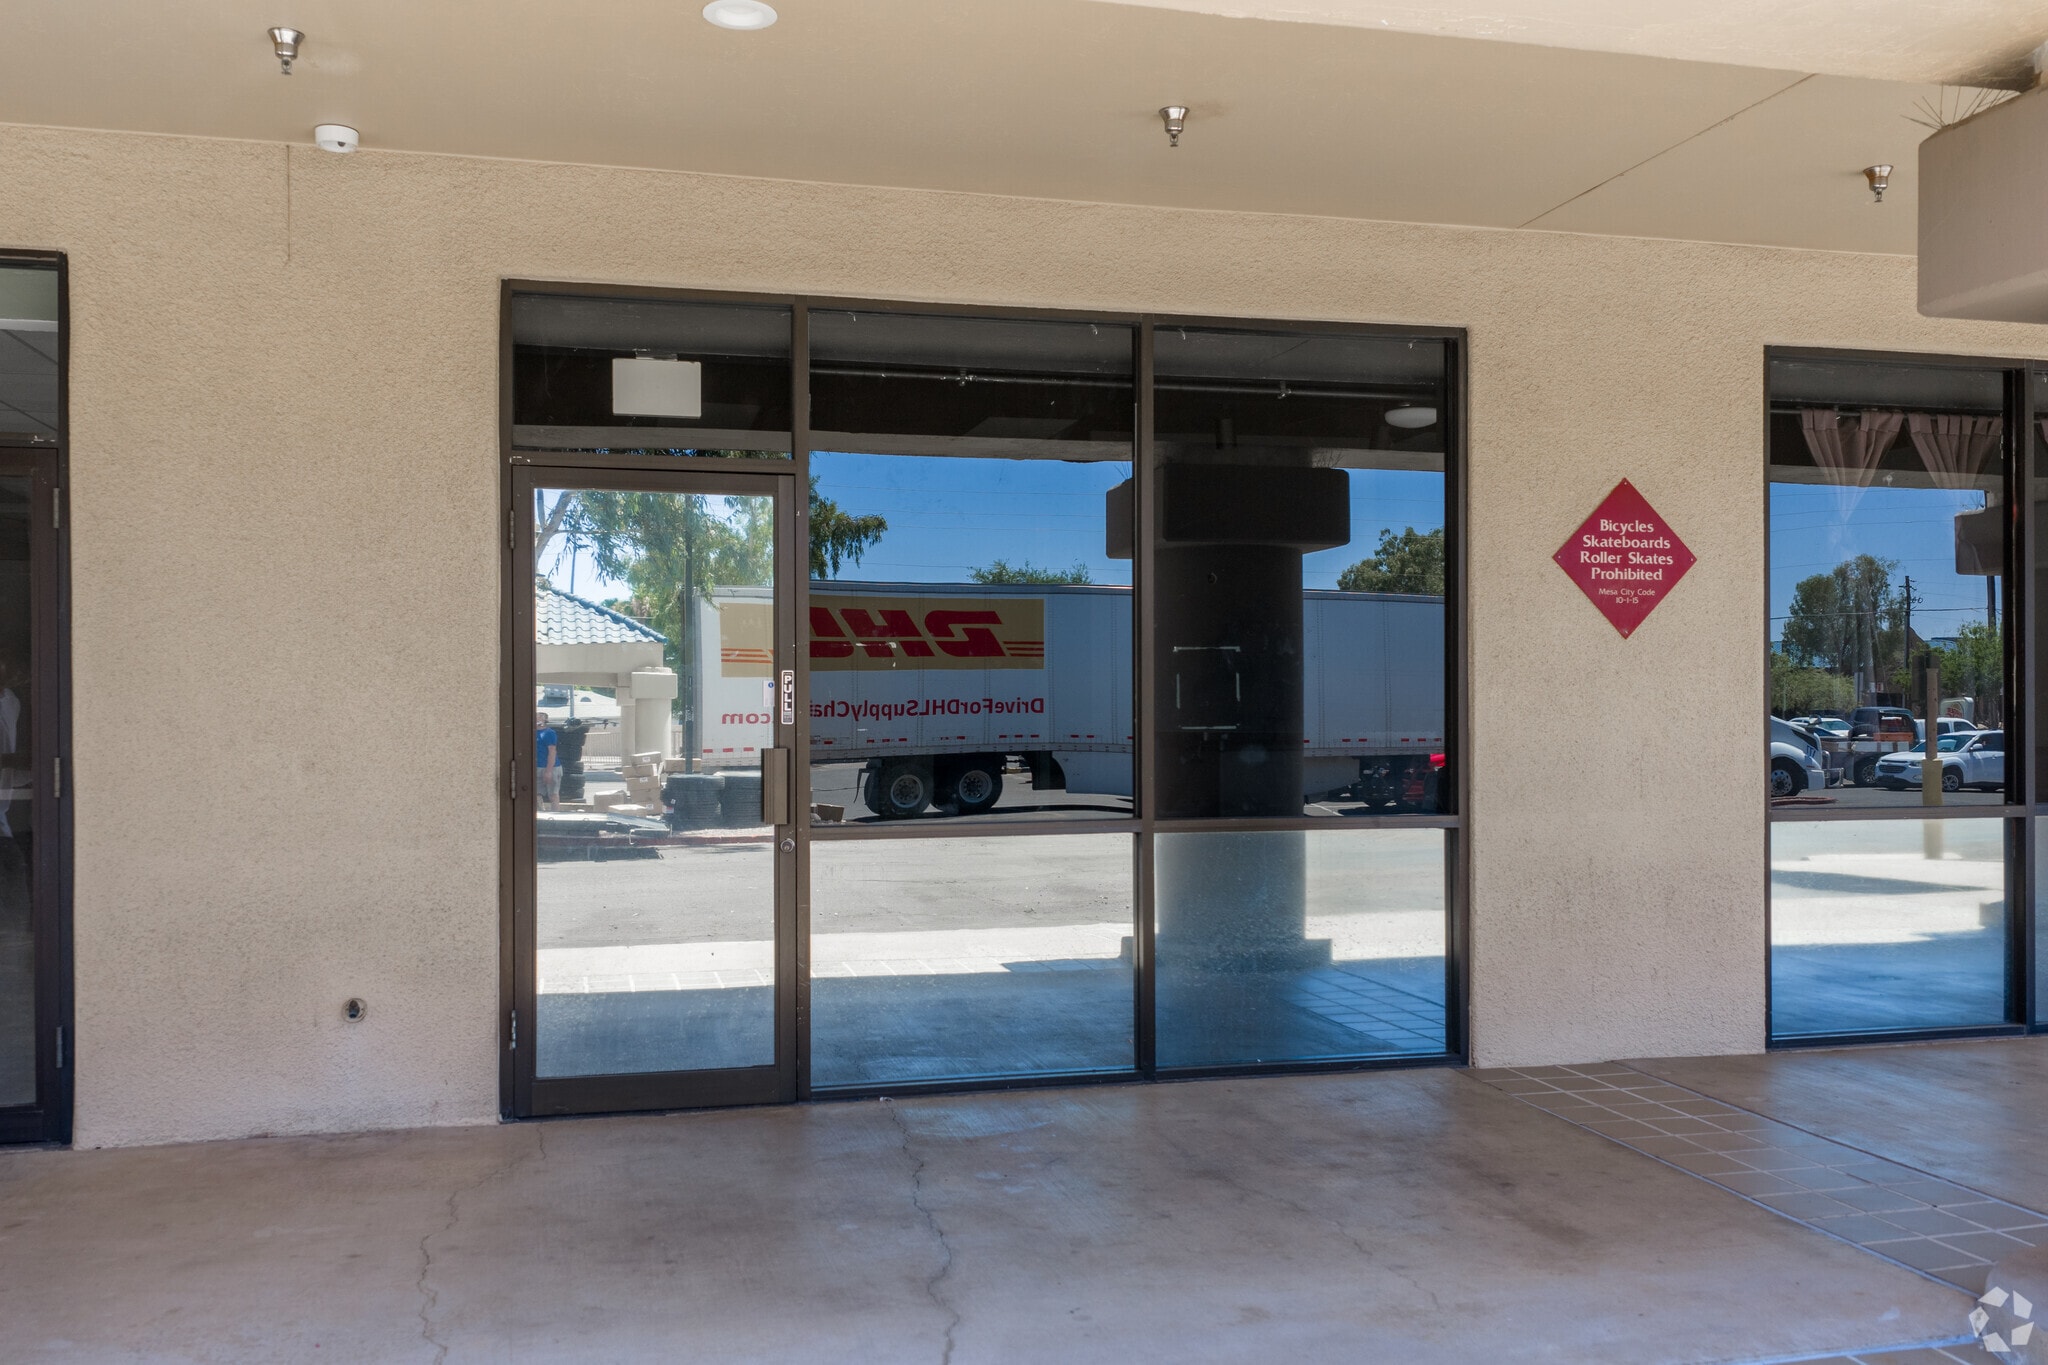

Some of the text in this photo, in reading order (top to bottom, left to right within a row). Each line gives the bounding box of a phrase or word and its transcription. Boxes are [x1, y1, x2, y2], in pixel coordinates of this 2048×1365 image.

[1600, 519, 1654, 535] Bicycles
[1583, 535, 1671, 549] Skateboards
[1580, 551, 1673, 565] Roller Skates
[1591, 567, 1663, 581] Prohibited
[1598, 588, 1656, 597] Mesa City Code
[784, 675, 792, 711] PULL
